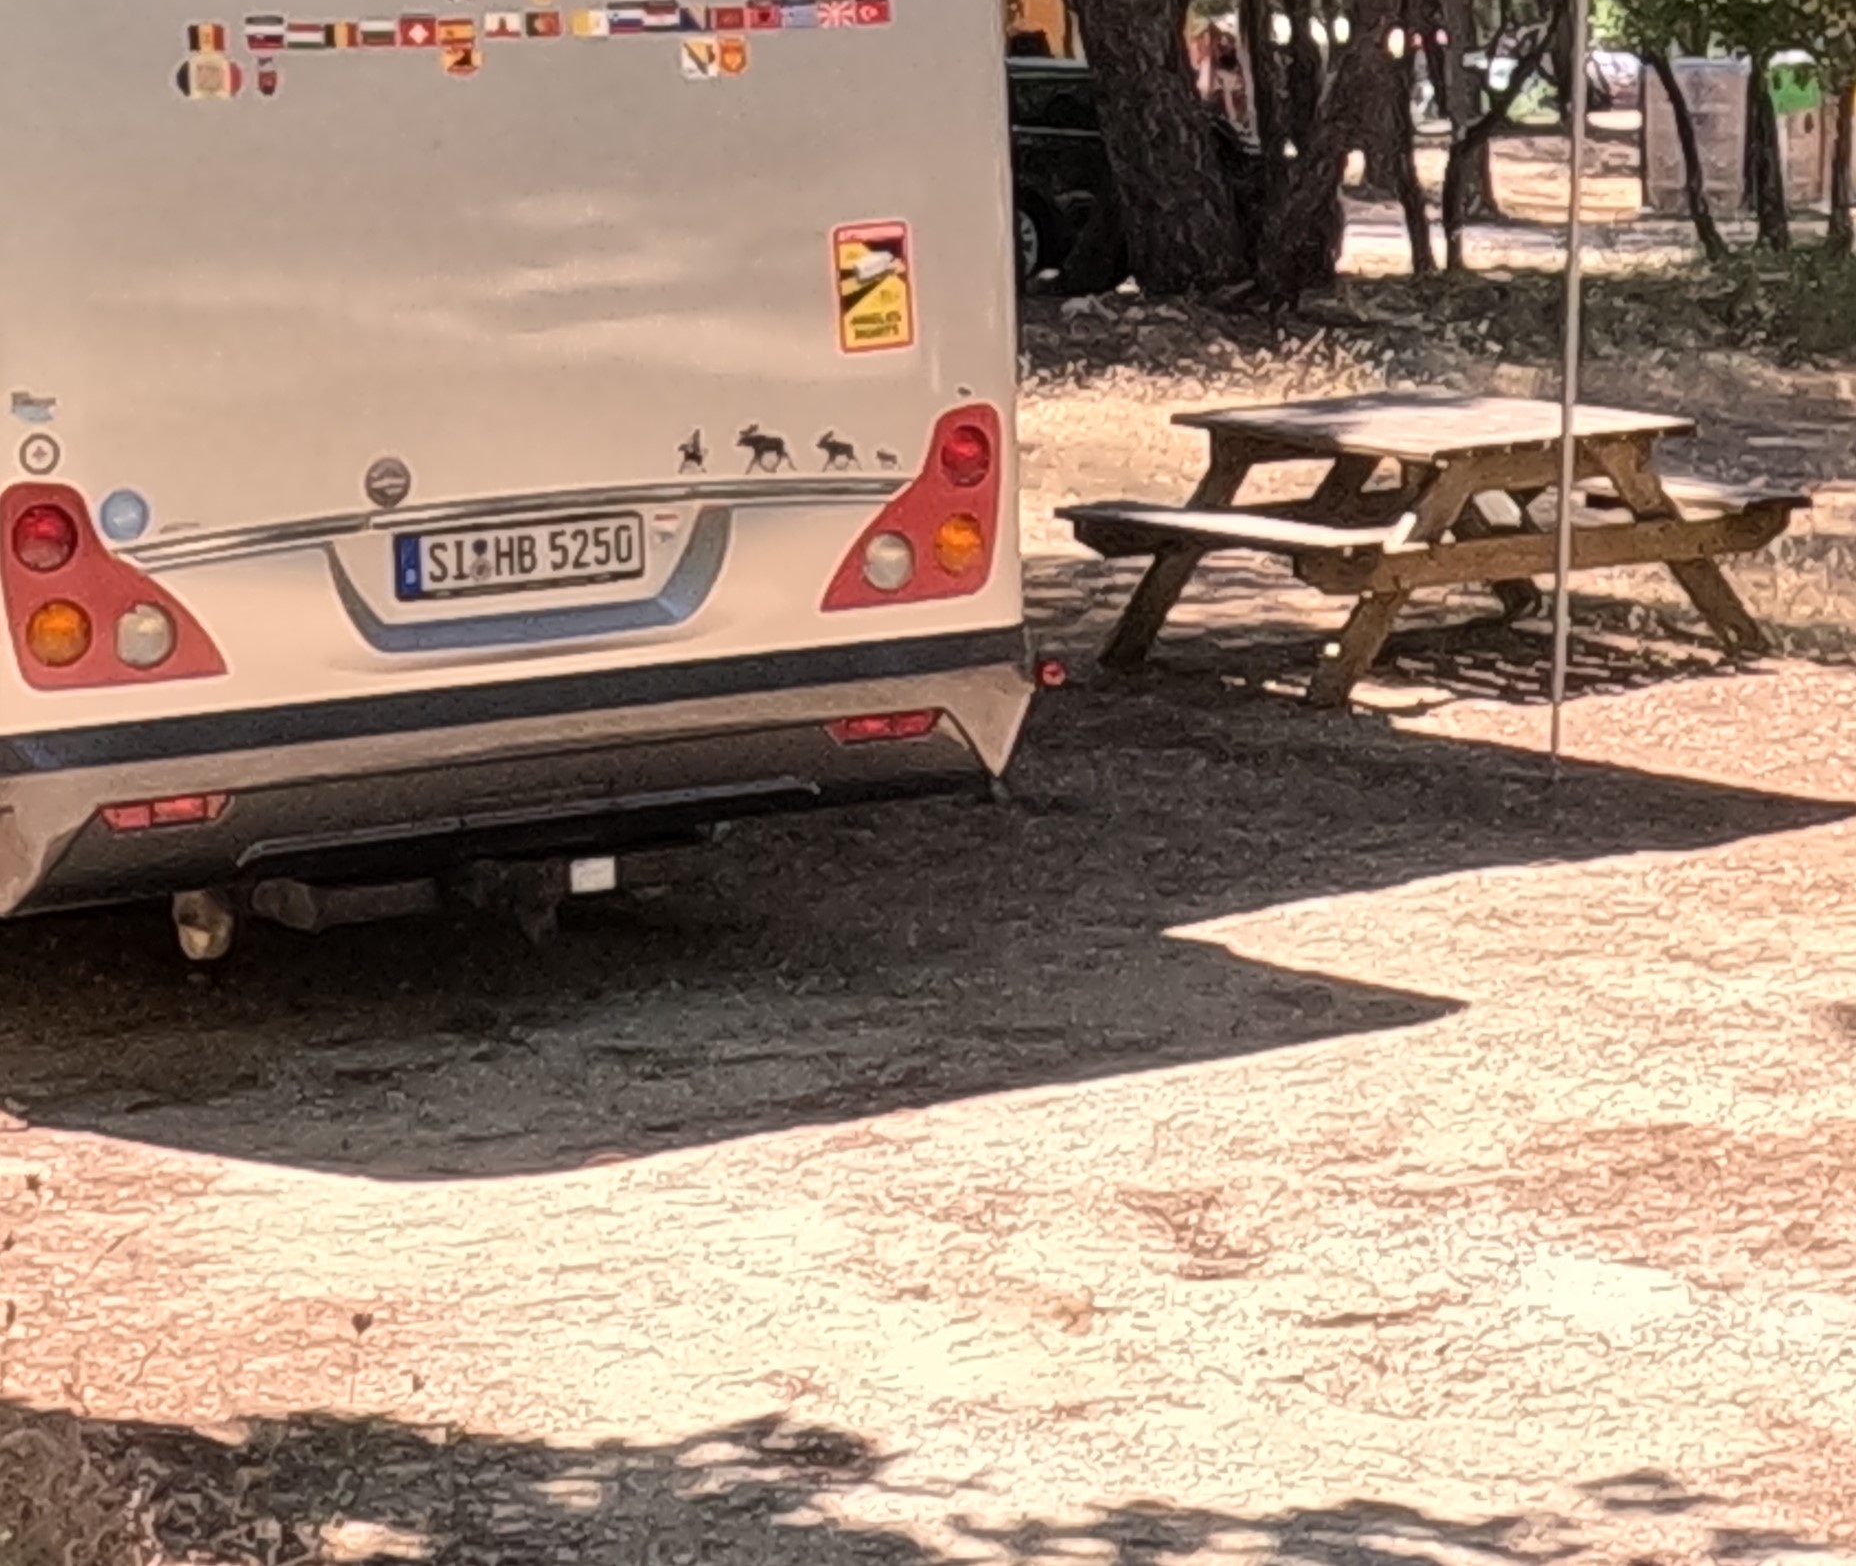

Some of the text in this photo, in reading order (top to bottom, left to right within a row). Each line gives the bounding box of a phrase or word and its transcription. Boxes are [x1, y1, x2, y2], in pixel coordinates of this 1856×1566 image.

[429, 525, 632, 583] SI HB 5250
